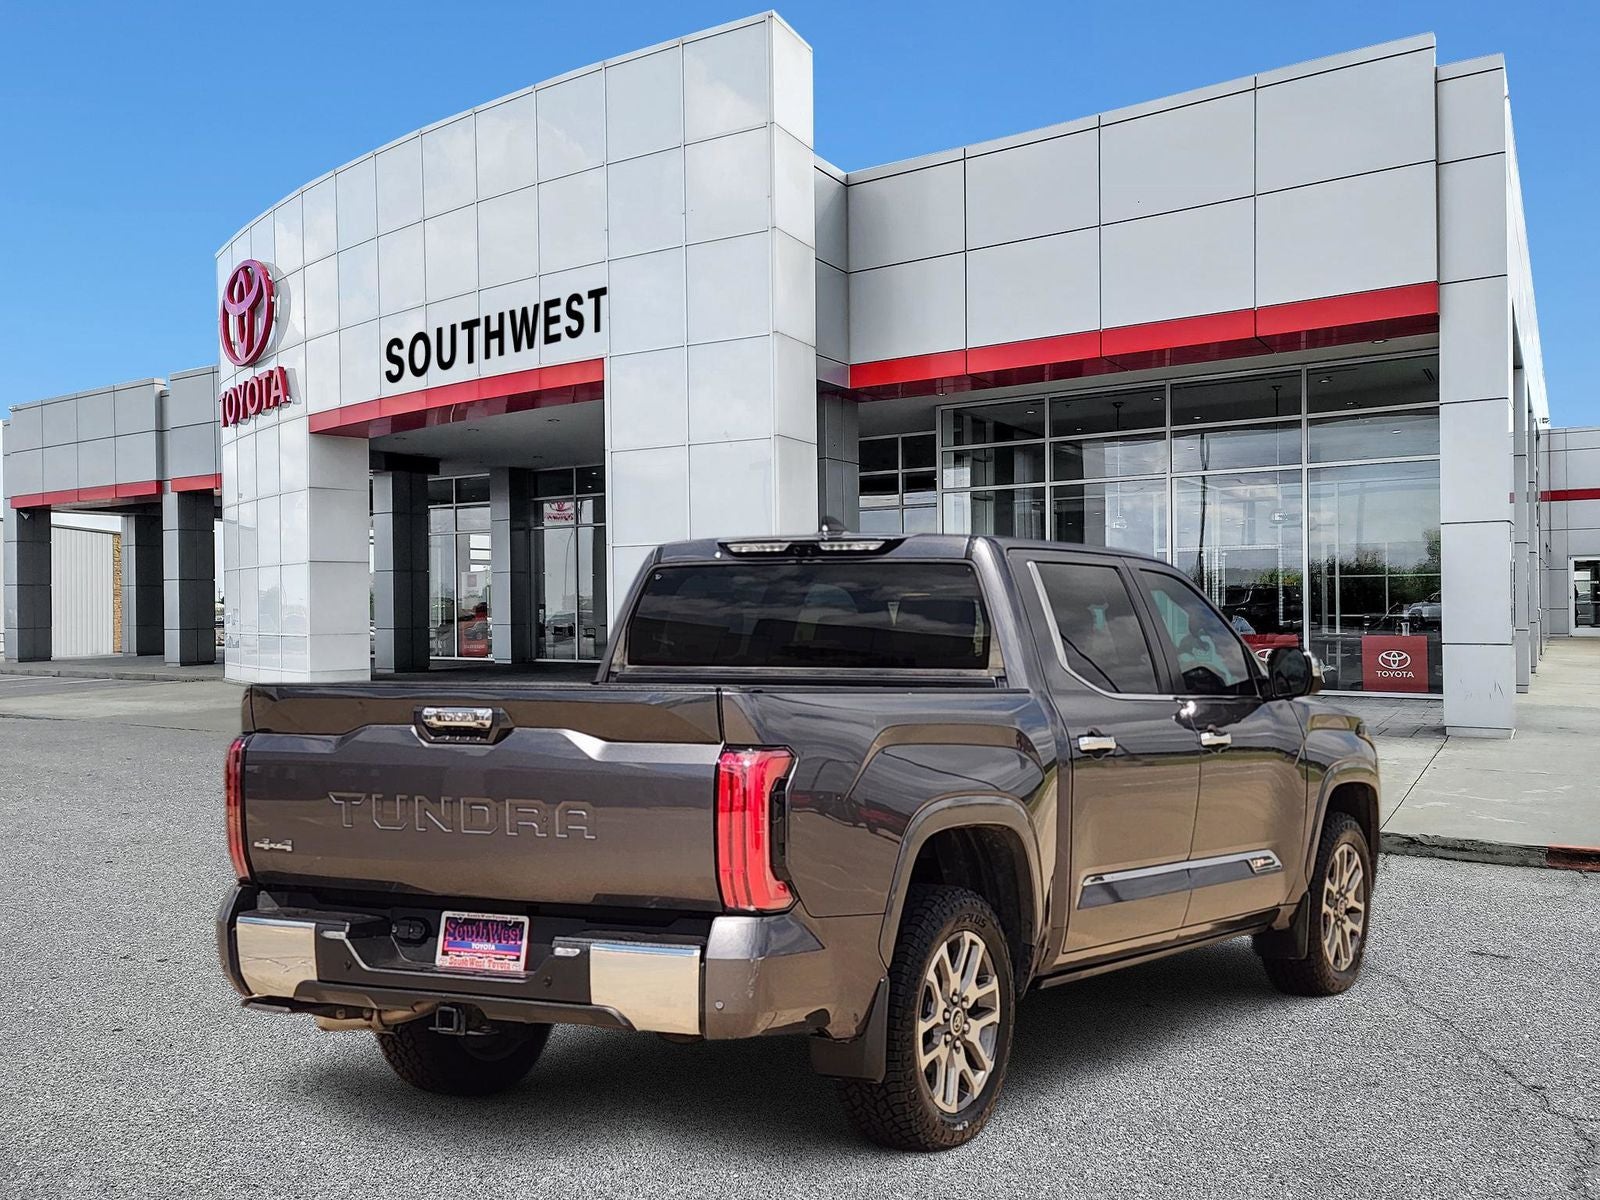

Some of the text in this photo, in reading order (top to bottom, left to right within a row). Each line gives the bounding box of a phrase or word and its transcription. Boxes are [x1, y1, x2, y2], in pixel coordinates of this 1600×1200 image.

[385, 286, 608, 384] SOUTHWEST
[219, 366, 292, 428] TOYOTA
[1376, 670, 1415, 678] TOYOTA
[328, 792, 597, 840] TUNDRA
[471, 942, 496, 951] TOYOTA
